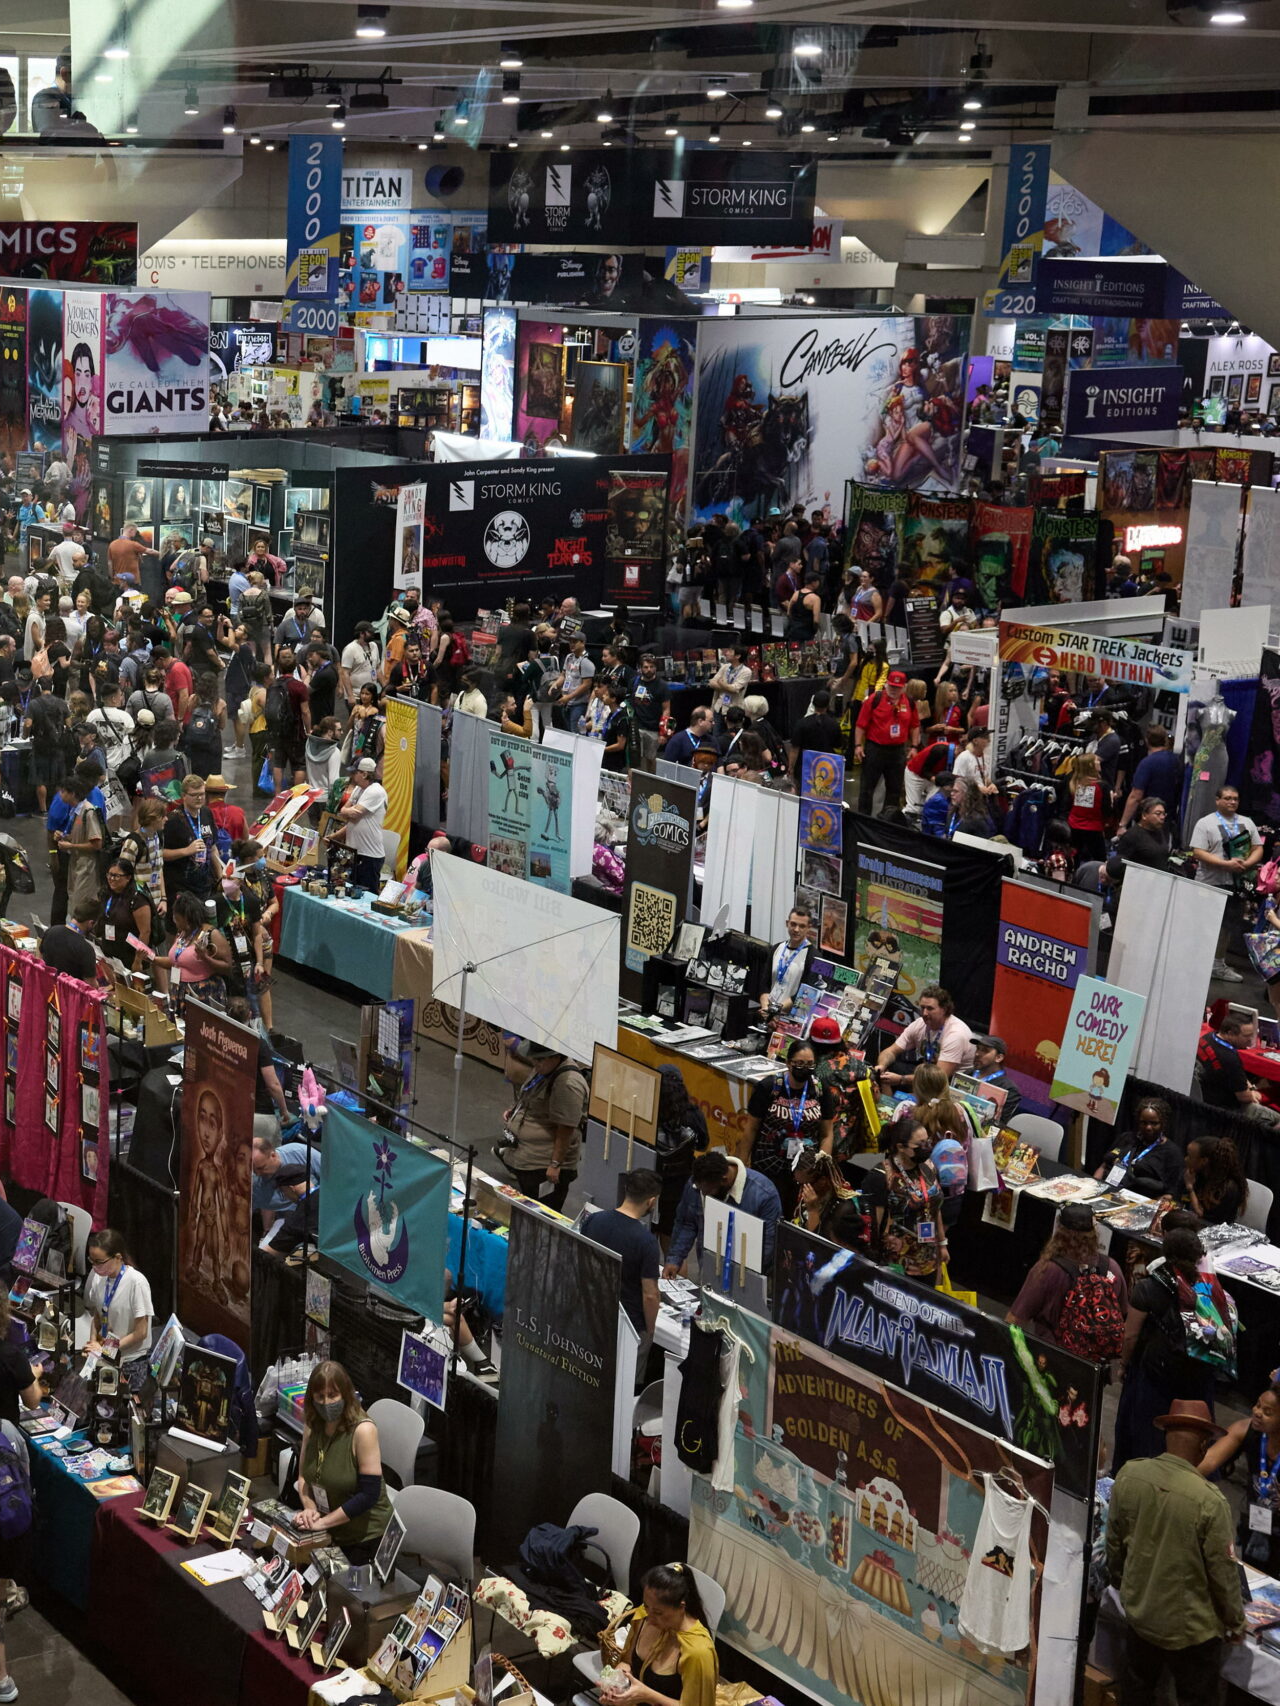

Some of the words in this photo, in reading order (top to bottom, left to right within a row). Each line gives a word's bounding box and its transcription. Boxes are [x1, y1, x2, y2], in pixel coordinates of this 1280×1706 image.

[304, 142, 322, 241] 2000
[342, 177, 402, 197] TITAN
[692, 188, 745, 206] STORM
[749, 188, 787, 206] KING
[1017, 151, 1037, 238] 2200
[342, 199, 401, 207] ENTERTAINMENT
[545, 206, 570, 217] STORM
[547, 217, 567, 227] KING
[192, 255, 285, 269] TELEPHONES
[309, 254, 327, 265] CON
[560, 258, 583, 272] Disney
[676, 250, 686, 284] COMIC
[685, 252, 701, 264] CON
[150, 271, 159, 284] C
[299, 254, 309, 287] COMIC
[1053, 279, 1094, 291] INSIGHT
[1103, 282, 1145, 293] EDITIONS
[67, 303, 99, 322] VIOLENT
[1001, 295, 1036, 314] 220
[1182, 301, 1210, 309] CRAFTING
[67, 319, 100, 338] FLOWERS
[297, 307, 336, 331] 2000
[990, 345, 1014, 356] ALEX
[1210, 360, 1234, 372] ALEX
[1238, 359, 1264, 370] ROSS
[109, 381, 125, 389] WE
[129, 380, 170, 389] CALLED
[176, 379, 204, 387] THEM
[40, 394, 57, 408] LAST
[106, 388, 206, 414] GIANTS
[1102, 387, 1166, 406] INSIGHT
[1106, 406, 1158, 417] EDITIONS
[476, 468, 500, 476] Carpenter
[501, 466, 510, 474] and
[511, 466, 526, 474] Sandy
[526, 466, 537, 474] King
[404, 489, 423, 500] SANDY
[481, 483, 526, 499] STORM
[529, 482, 562, 496] KING
[852, 485, 908, 512] MONSTERS
[404, 500, 422, 514] KING
[908, 494, 968, 520] MONSTERS
[972, 502, 1031, 530] MONSTERS
[1034, 510, 1099, 539] MONSTERS
[554, 537, 588, 552] NIGHT
[1006, 624, 1054, 645] Custom
[1057, 633, 1089, 649] STAR
[1092, 638, 1127, 661] TREK
[1130, 645, 1184, 668] Jackets
[1060, 652, 1095, 674] HERO
[1100, 659, 1154, 685] WITHIN
[532, 750, 542, 759] OUT
[549, 755, 560, 765] STEP
[560, 758, 571, 768] CLAY
[653, 821, 689, 846] COMICS
[1004, 929, 1077, 964] ANDREW
[1008, 947, 1067, 980] RACHO
[1090, 991, 1123, 1018] DARK
[1075, 1009, 1129, 1044] COMEDY
[200, 1021, 217, 1042] Josh
[217, 1030, 248, 1060] Figueroa
[1075, 1034, 1117, 1066] HERE!
[359, 1242, 387, 1280] Biolumen
[385, 1263, 403, 1280] Press
[873, 1280, 920, 1314] LEGEND
[920, 1303, 940, 1322] OF
[938, 1309, 964, 1334] THE
[516, 1307, 541, 1335] L.S.
[543, 1323, 604, 1370] JOHNSON
[516, 1333, 560, 1366] Unnatural
[560, 1355, 600, 1388] FICTION
[775, 1339, 803, 1364] THE
[824, 1287, 1015, 1441] MANTAMAJI
[776, 1373, 879, 1420] ADVENTURES
[884, 1415, 904, 1444] OF
[785, 1413, 851, 1452] GOLDEN
[857, 1442, 901, 1480] A.S.S.
